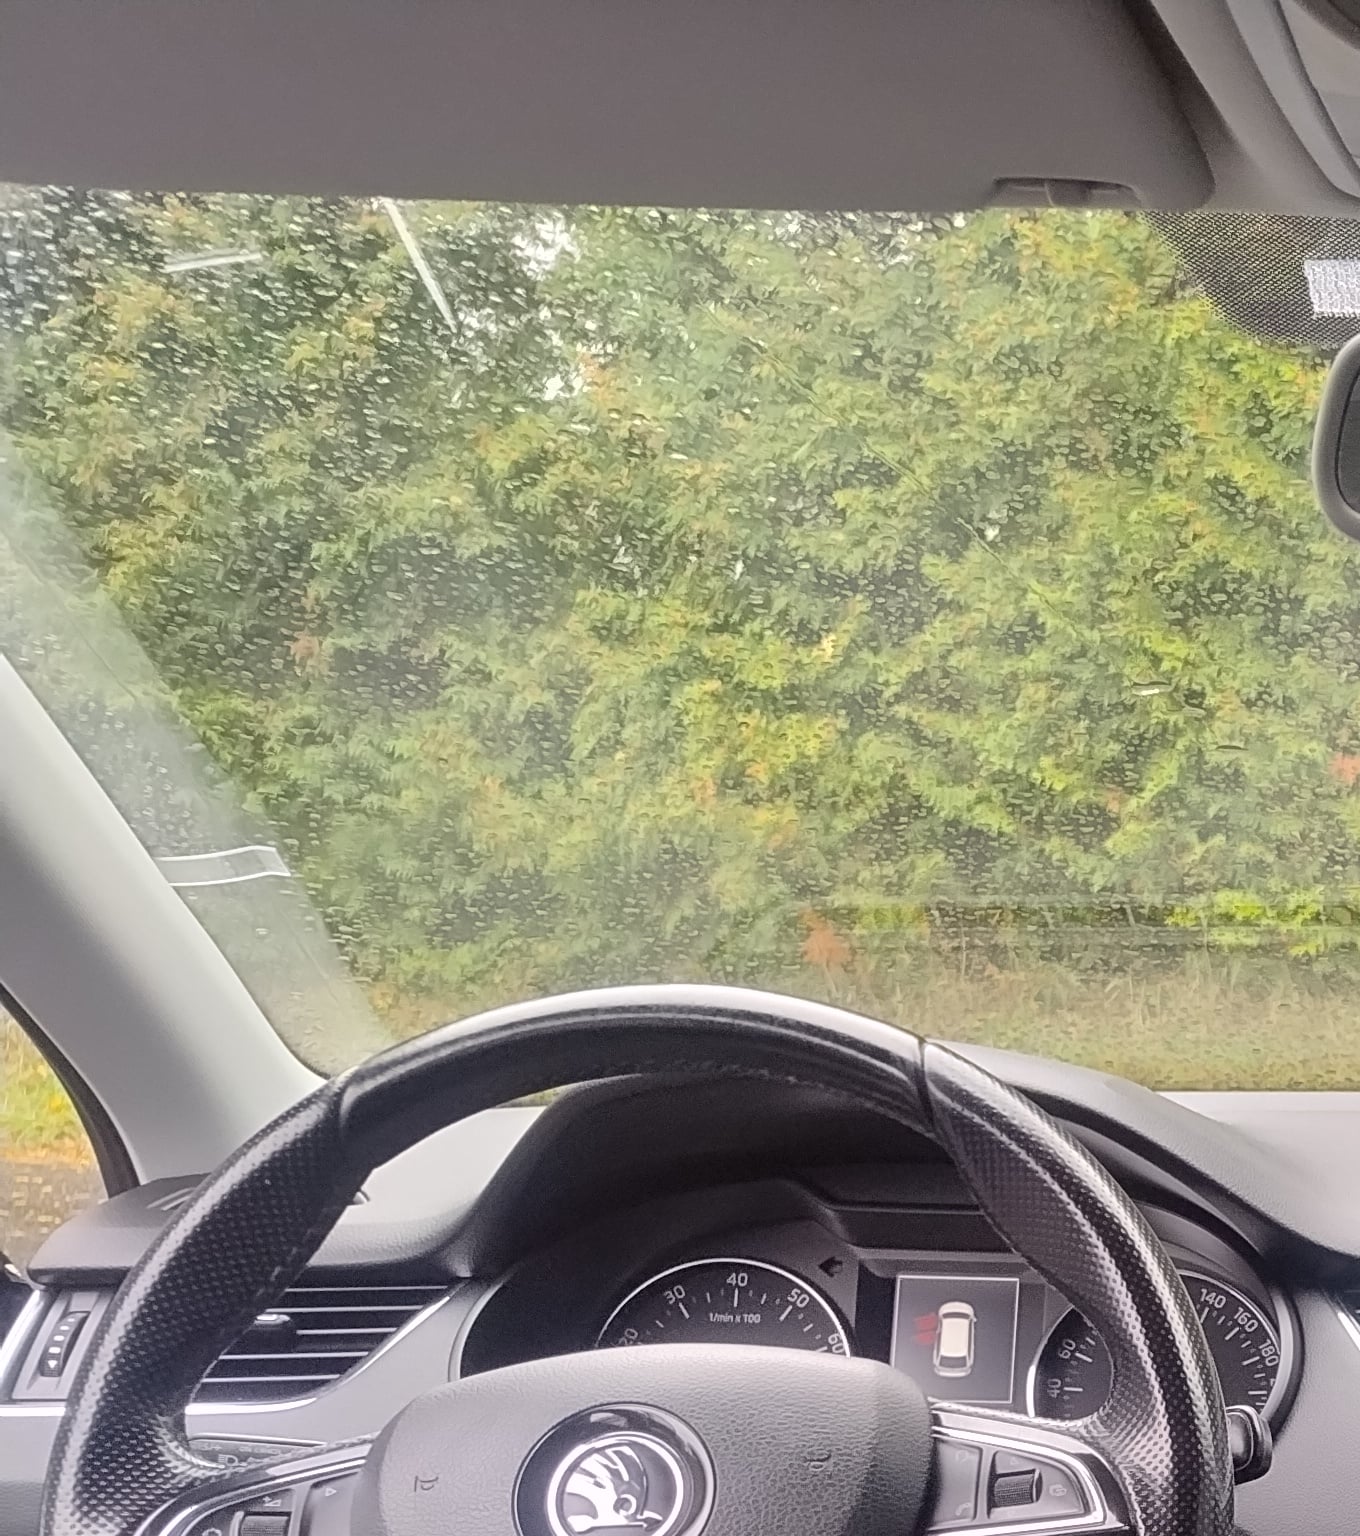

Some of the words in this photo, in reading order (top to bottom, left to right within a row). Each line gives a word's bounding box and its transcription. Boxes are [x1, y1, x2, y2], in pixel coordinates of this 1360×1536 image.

[726, 1272, 748, 1287] 40
[663, 1285, 686, 1304] 30
[788, 1288, 810, 1309] 50
[1200, 1288, 1227, 1309] 140
[743, 1312, 761, 1324] 100
[1233, 1307, 1259, 1333] 160
[828, 1333, 845, 1354] 60
[1057, 1339, 1077, 1360] 60
[1258, 1339, 1280, 1367] 180
[1047, 1378, 1062, 1399] 40
